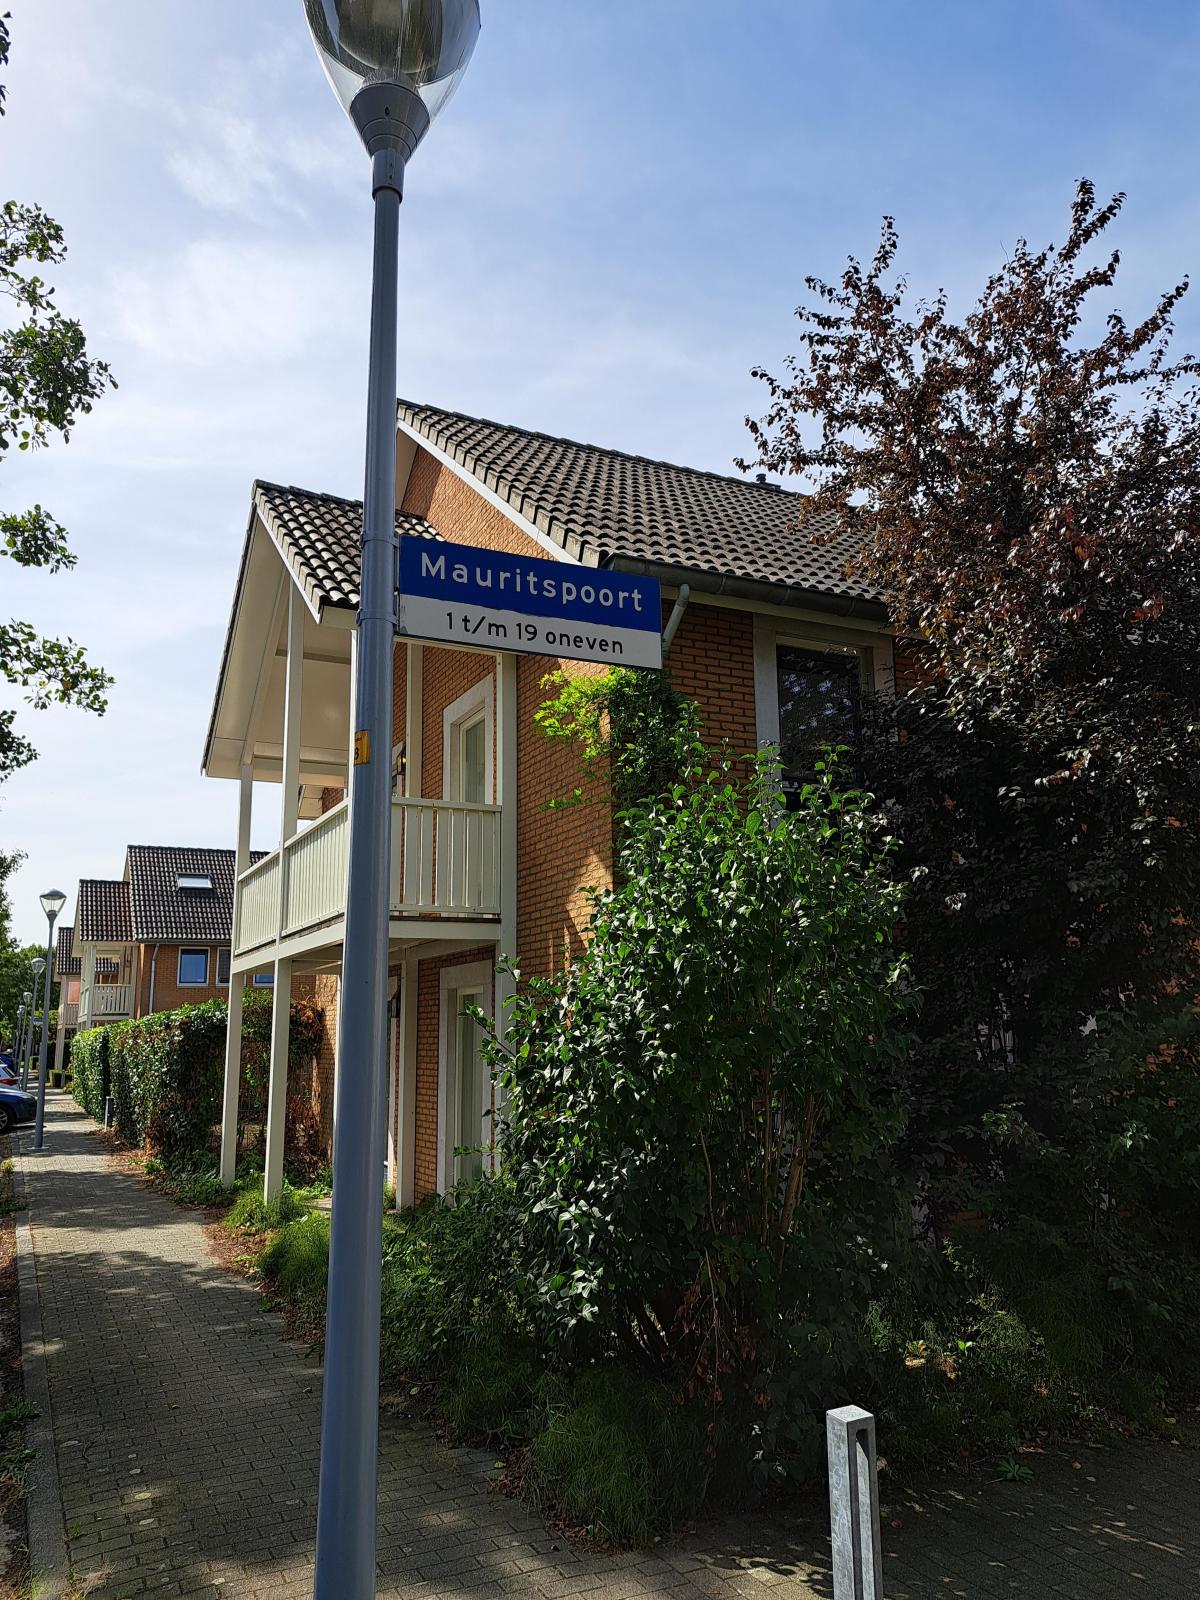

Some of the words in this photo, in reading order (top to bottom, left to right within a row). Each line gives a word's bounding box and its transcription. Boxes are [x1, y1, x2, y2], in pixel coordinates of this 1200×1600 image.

[421, 552, 642, 611] Mauritspoort
[446, 612, 453, 630] 1
[462, 614, 507, 638] t/m
[516, 623, 537, 641] 19
[545, 630, 623, 654] oneven
